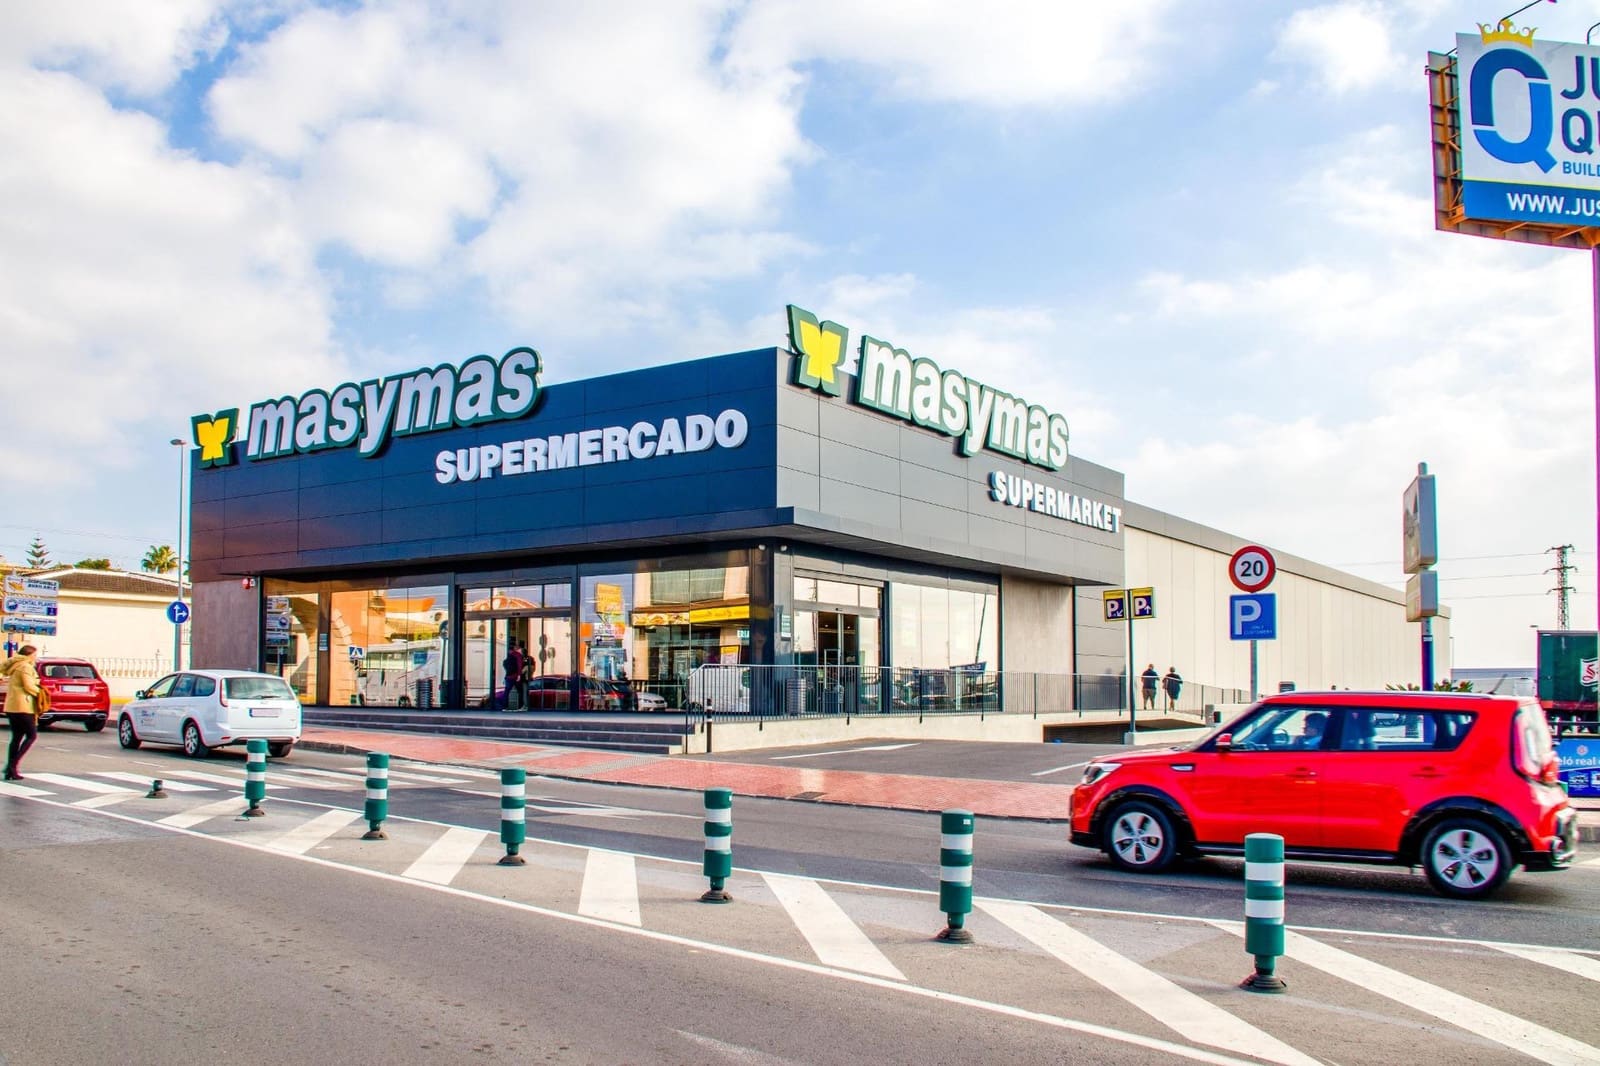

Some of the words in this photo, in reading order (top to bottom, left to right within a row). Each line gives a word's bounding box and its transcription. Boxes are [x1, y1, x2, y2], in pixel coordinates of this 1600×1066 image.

[1561, 108, 1600, 155] Q
[247, 346, 542, 458] masymas
[858, 335, 1070, 471] masymas
[435, 408, 749, 484] SUPERMERCADO
[989, 470, 1122, 533] SUPERMARKET
[1240, 559, 1264, 577] 20
[1106, 600, 1120, 618] P
[1134, 597, 1147, 615] P
[1234, 599, 1261, 635] P
[1575, 756, 1597, 766] real
